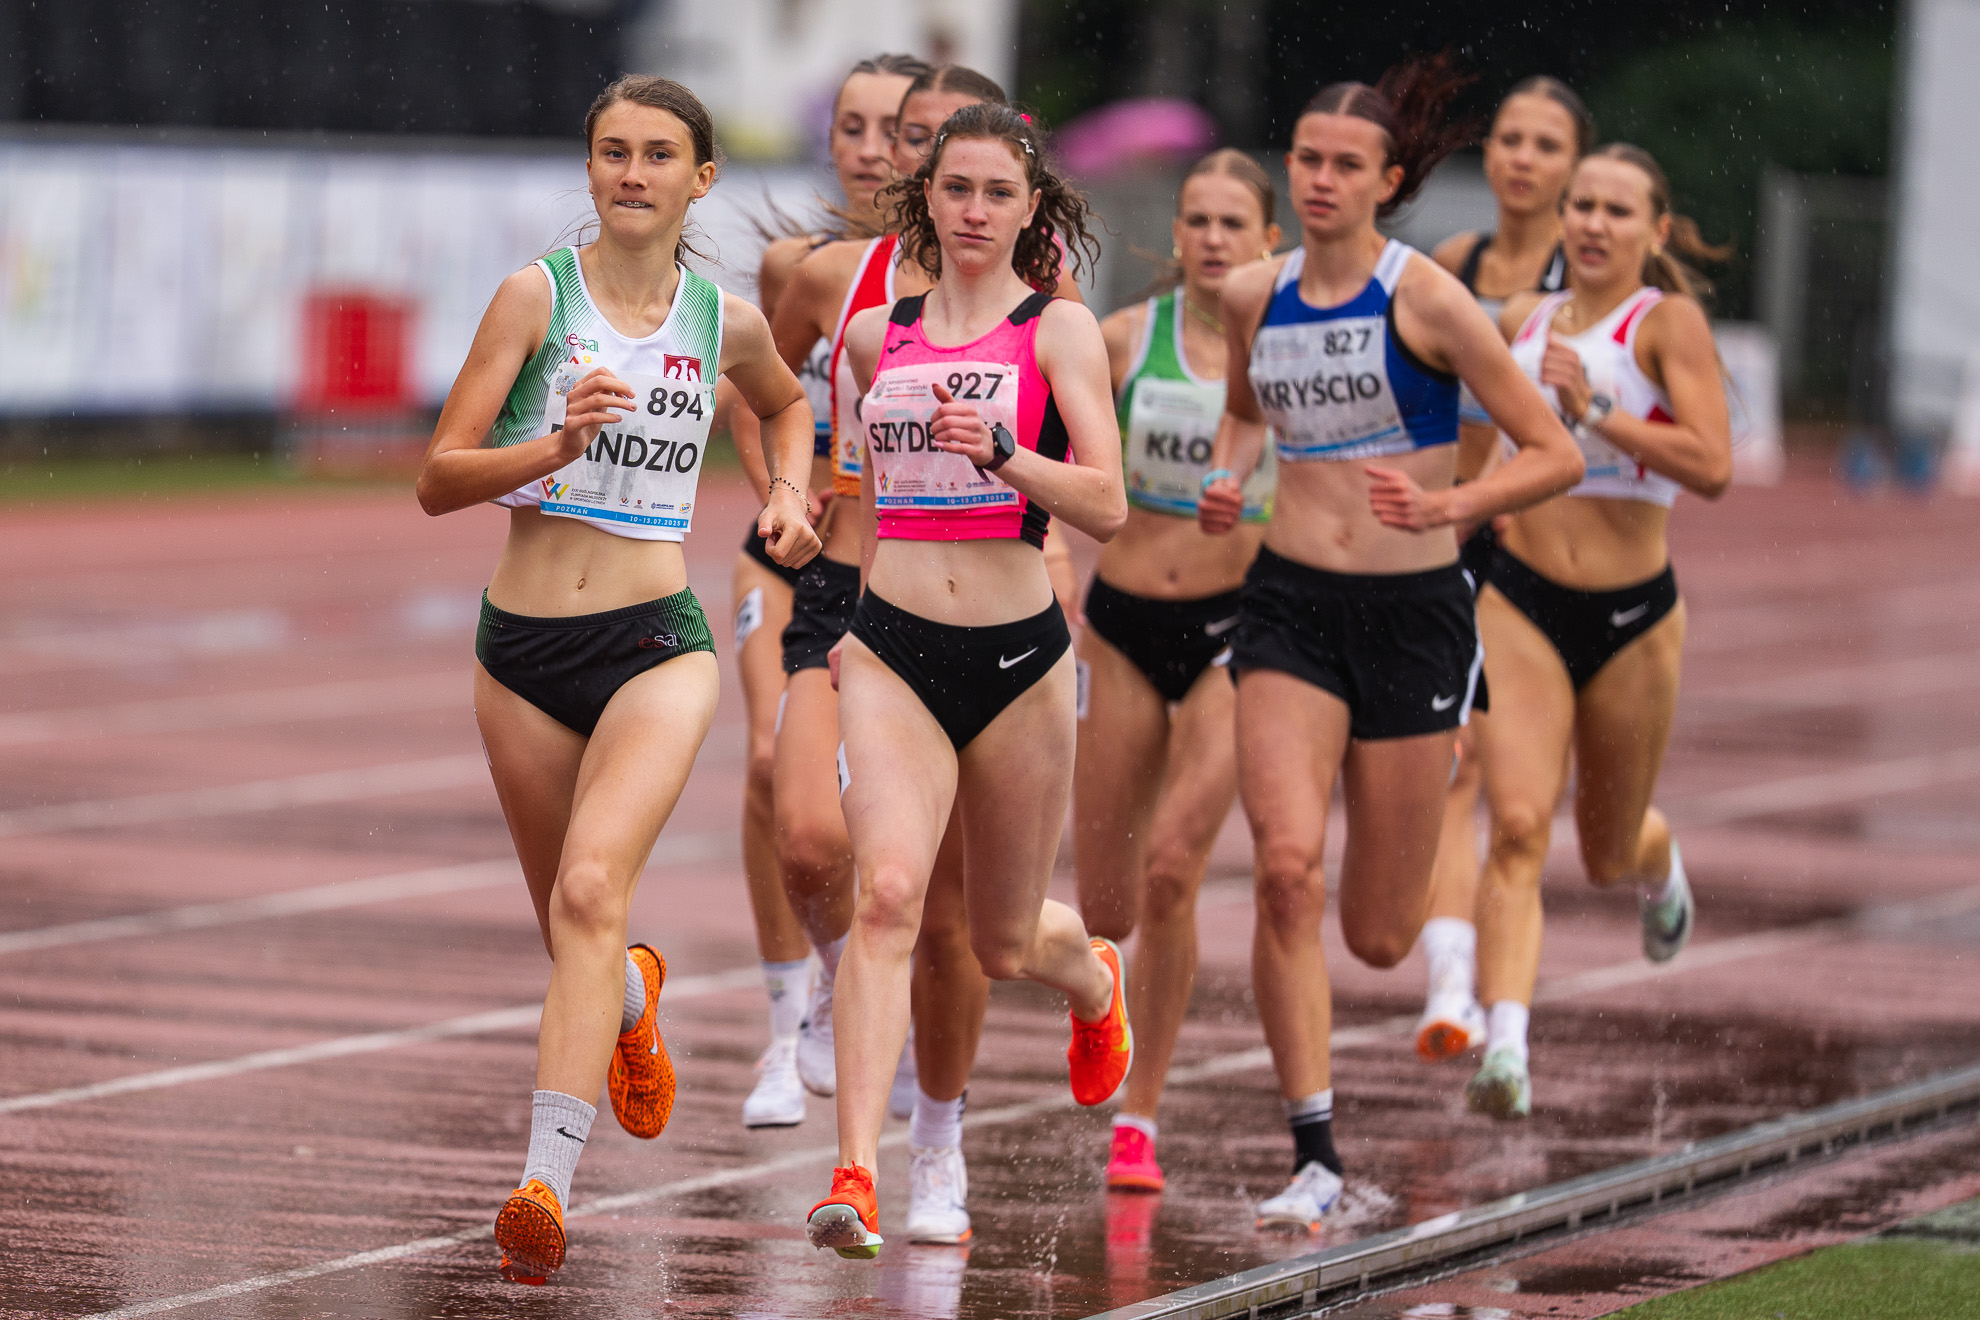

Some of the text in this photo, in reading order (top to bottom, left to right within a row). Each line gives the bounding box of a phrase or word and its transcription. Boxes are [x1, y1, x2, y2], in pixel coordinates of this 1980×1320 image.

[1323, 328, 1372, 356] 827
[946, 372, 1004, 400] 927
[1257, 369, 1381, 411] KRYŚCIO
[647, 387, 704, 421] 894
[555, 505, 588, 515] POZNAŃ
